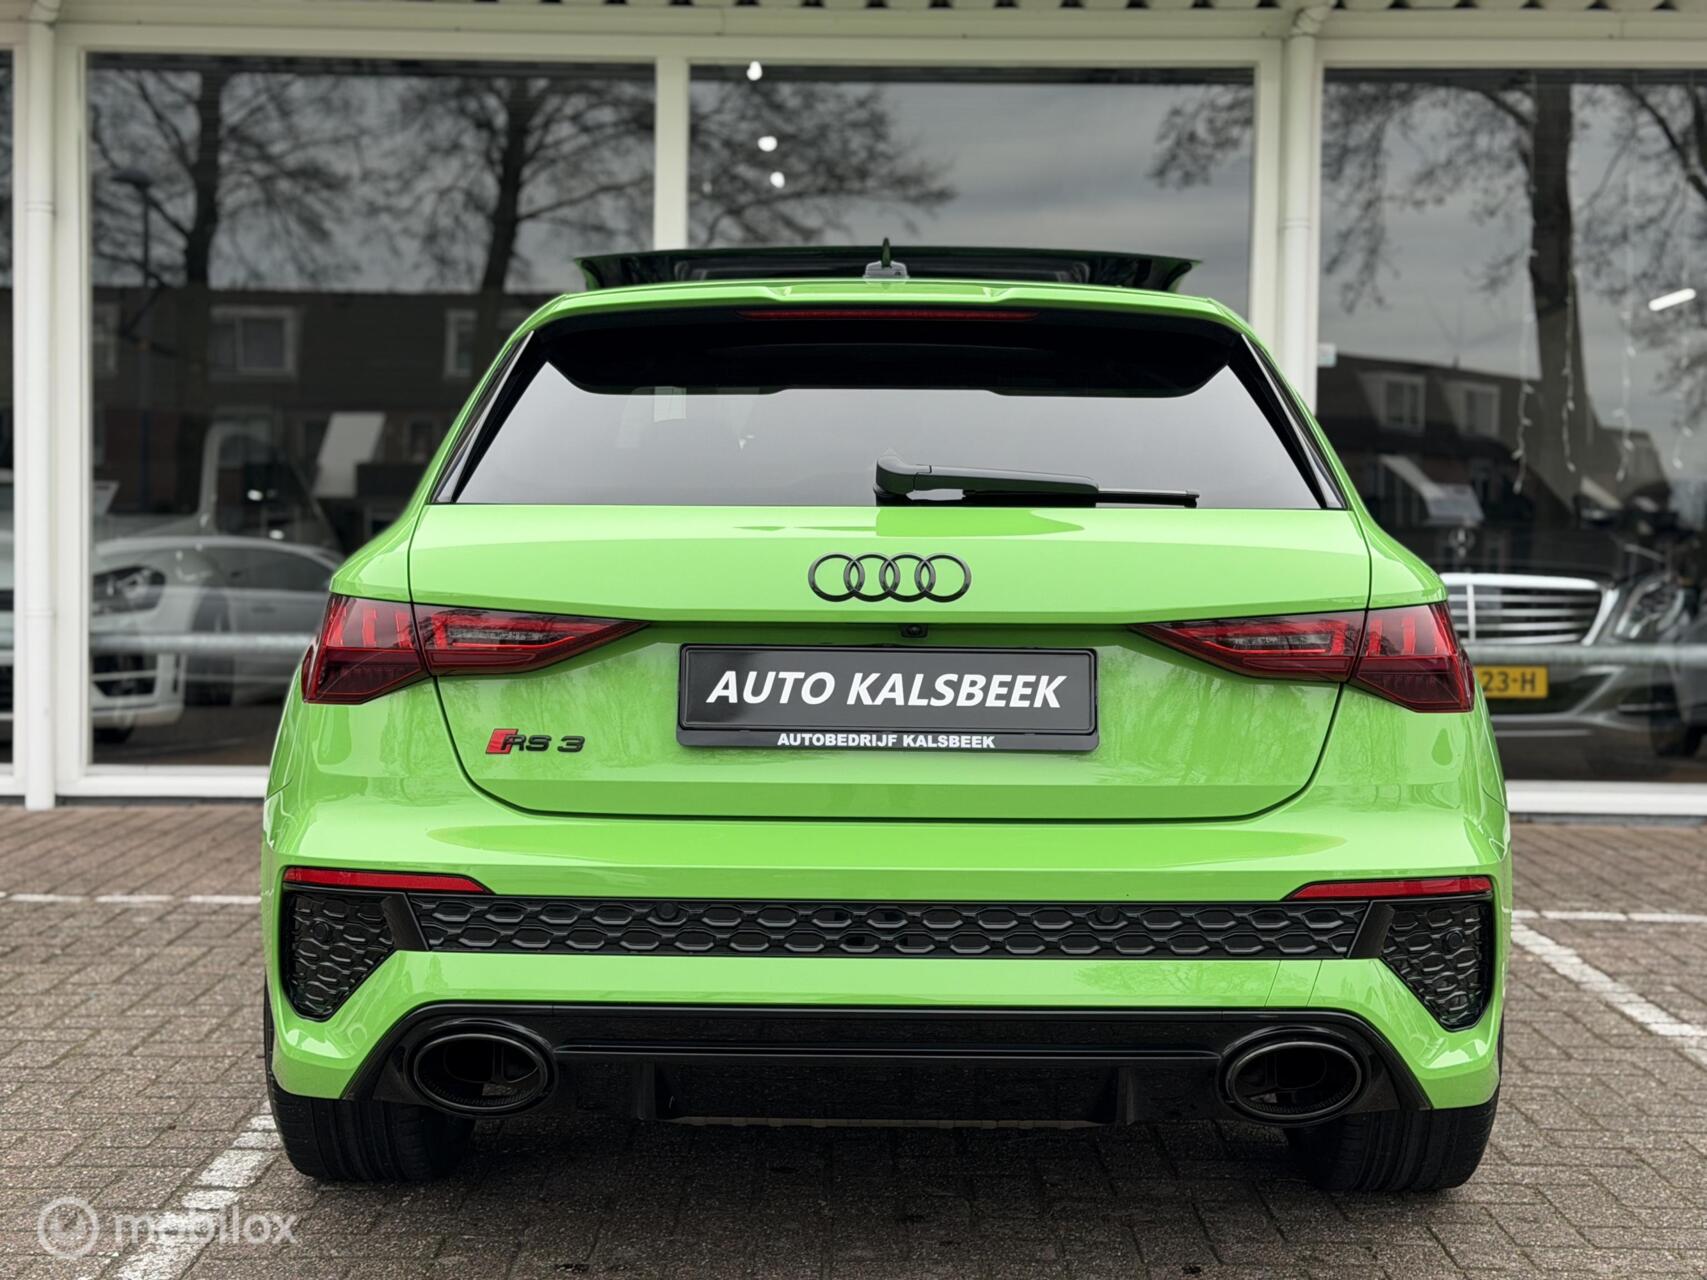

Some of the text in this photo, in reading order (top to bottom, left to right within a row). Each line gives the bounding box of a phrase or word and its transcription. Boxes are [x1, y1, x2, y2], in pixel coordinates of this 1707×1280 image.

[706, 671, 1068, 708] AUTO KALSBEEK
[500, 734, 586, 753] RS 3
[777, 733, 996, 749] AUTOBEDRIJF KALSBEEK
